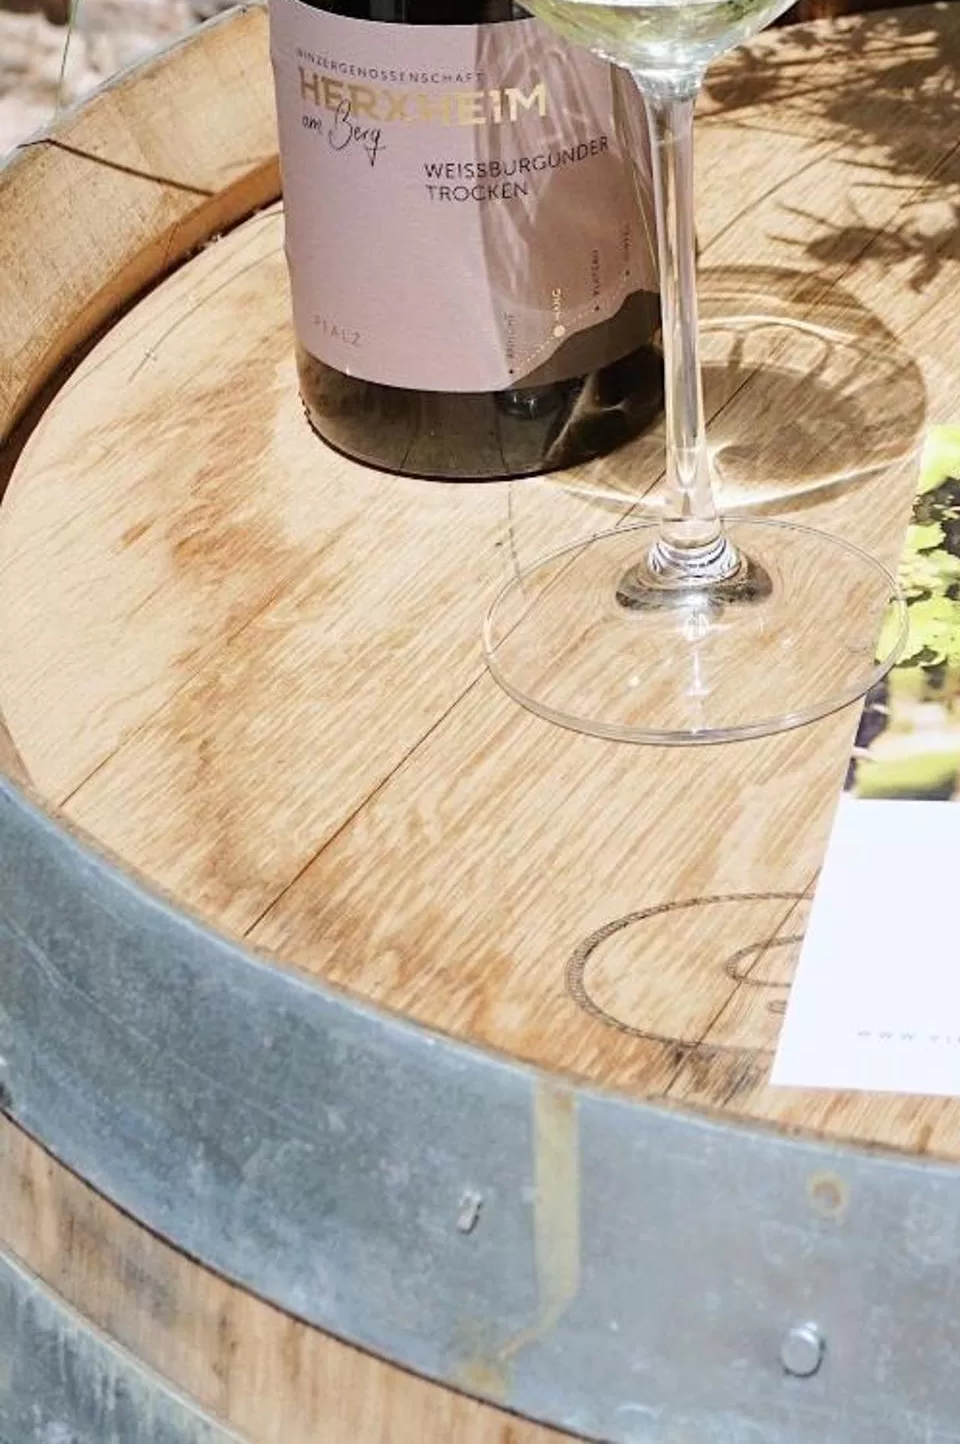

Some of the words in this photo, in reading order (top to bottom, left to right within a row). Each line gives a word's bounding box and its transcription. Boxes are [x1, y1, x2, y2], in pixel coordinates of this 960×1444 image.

[298, 67, 547, 127] HERXHEIM
[328, 98, 387, 167] Berg
[424, 136, 610, 179] WEISSBURGUNDER
[425, 182, 528, 202] TROCKEN
